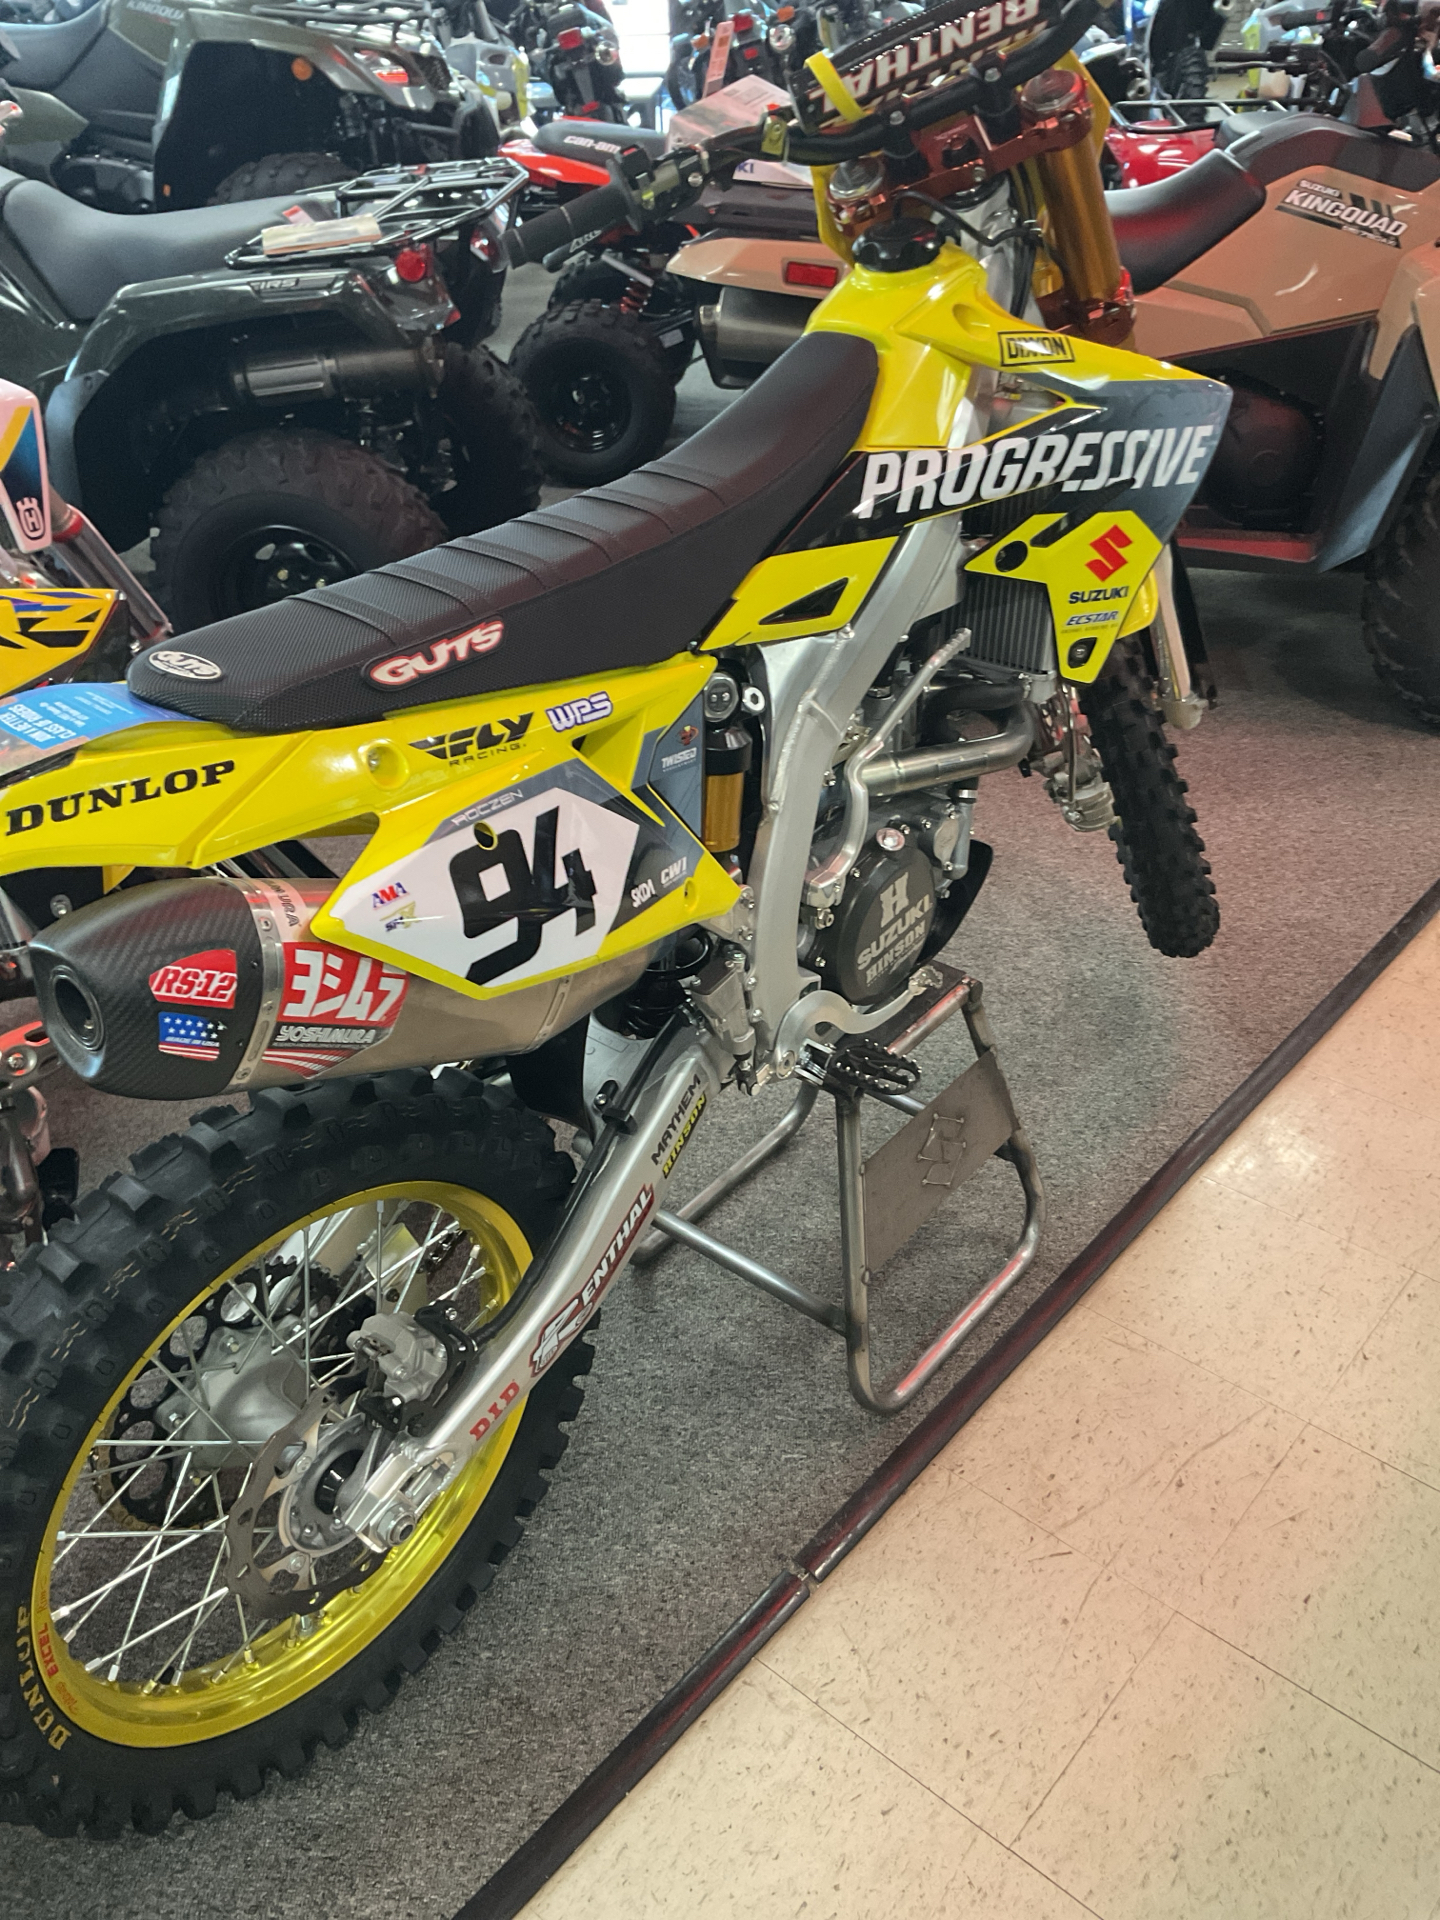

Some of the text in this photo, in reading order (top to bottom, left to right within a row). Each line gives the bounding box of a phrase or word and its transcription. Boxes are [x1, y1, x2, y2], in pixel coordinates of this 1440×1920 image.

[1284, 189, 1408, 236] KINGQUAD
[1299, 179, 1341, 198] SUZUKI
[852, 425, 1214, 519] PROGRESSIVE
[1066, 610, 1119, 626] ECSTAR
[1068, 585, 1130, 605] SUZUKI
[370, 620, 504, 685] GUTS
[408, 711, 534, 760] FLY
[546, 691, 613, 732] WPS
[6, 760, 235, 836] DUNLOP
[450, 788, 524, 827] ROCZEN
[371, 881, 409, 909] AMA
[449, 805, 597, 987] 94
[857, 894, 930, 970] SUZUKI
[275, 1025, 377, 1045] YOSHIMURA
[652, 1074, 700, 1165] MAYHEM
[663, 1094, 707, 1178] HINSON
[37, 1623, 60, 1678] EXCEL
[16, 1604, 72, 1751] DUNLOP
